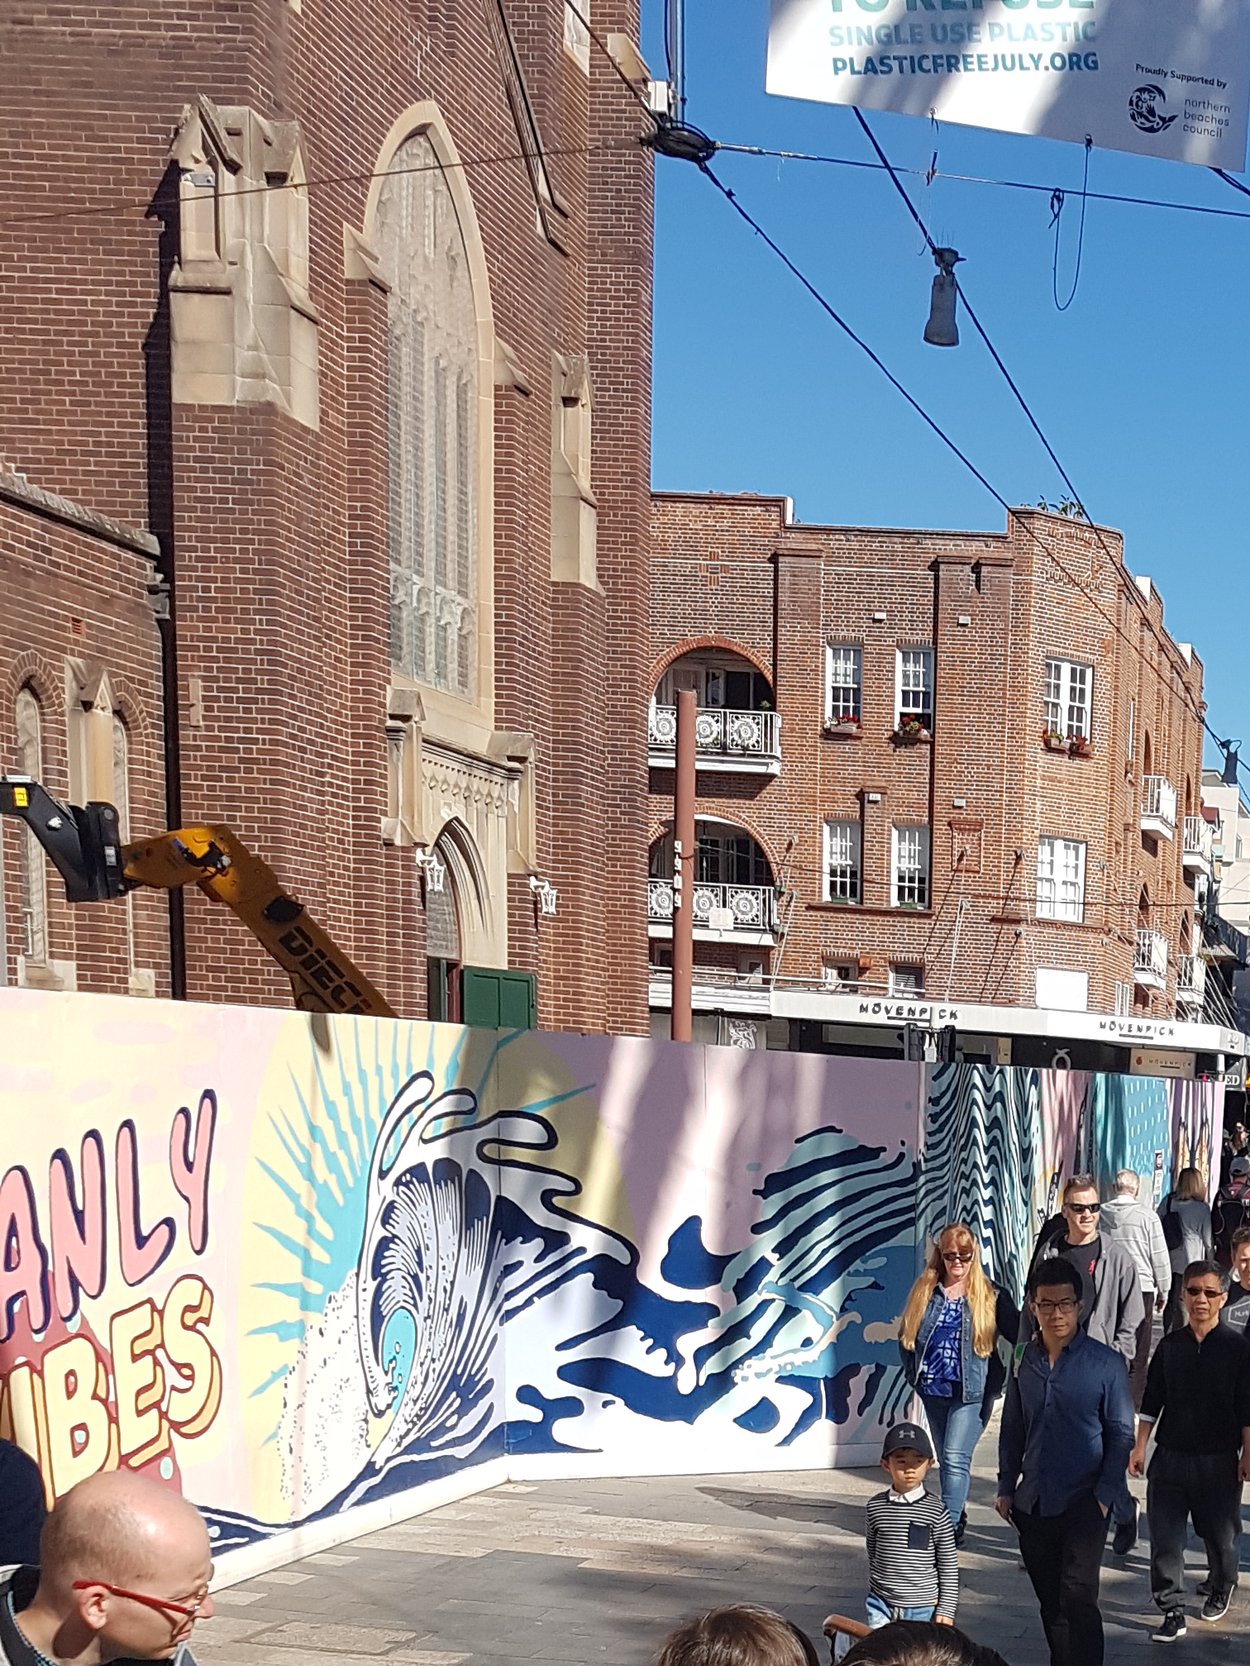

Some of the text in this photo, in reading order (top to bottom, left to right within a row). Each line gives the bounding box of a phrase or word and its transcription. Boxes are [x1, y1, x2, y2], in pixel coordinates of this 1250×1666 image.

[829, 20, 1097, 47] SINGLE USE PLASTIC
[832, 51, 1099, 76] PLASTICFREEJULY.ORG
[1135, 63, 1228, 89] Proudly Supported by
[1184, 98, 1231, 113] northern
[1183, 110, 1230, 126] beaches
[1182, 124, 1223, 139] council
[859, 1002, 958, 1020] MÖVENPCK
[0, 1274, 222, 1512] IBES
